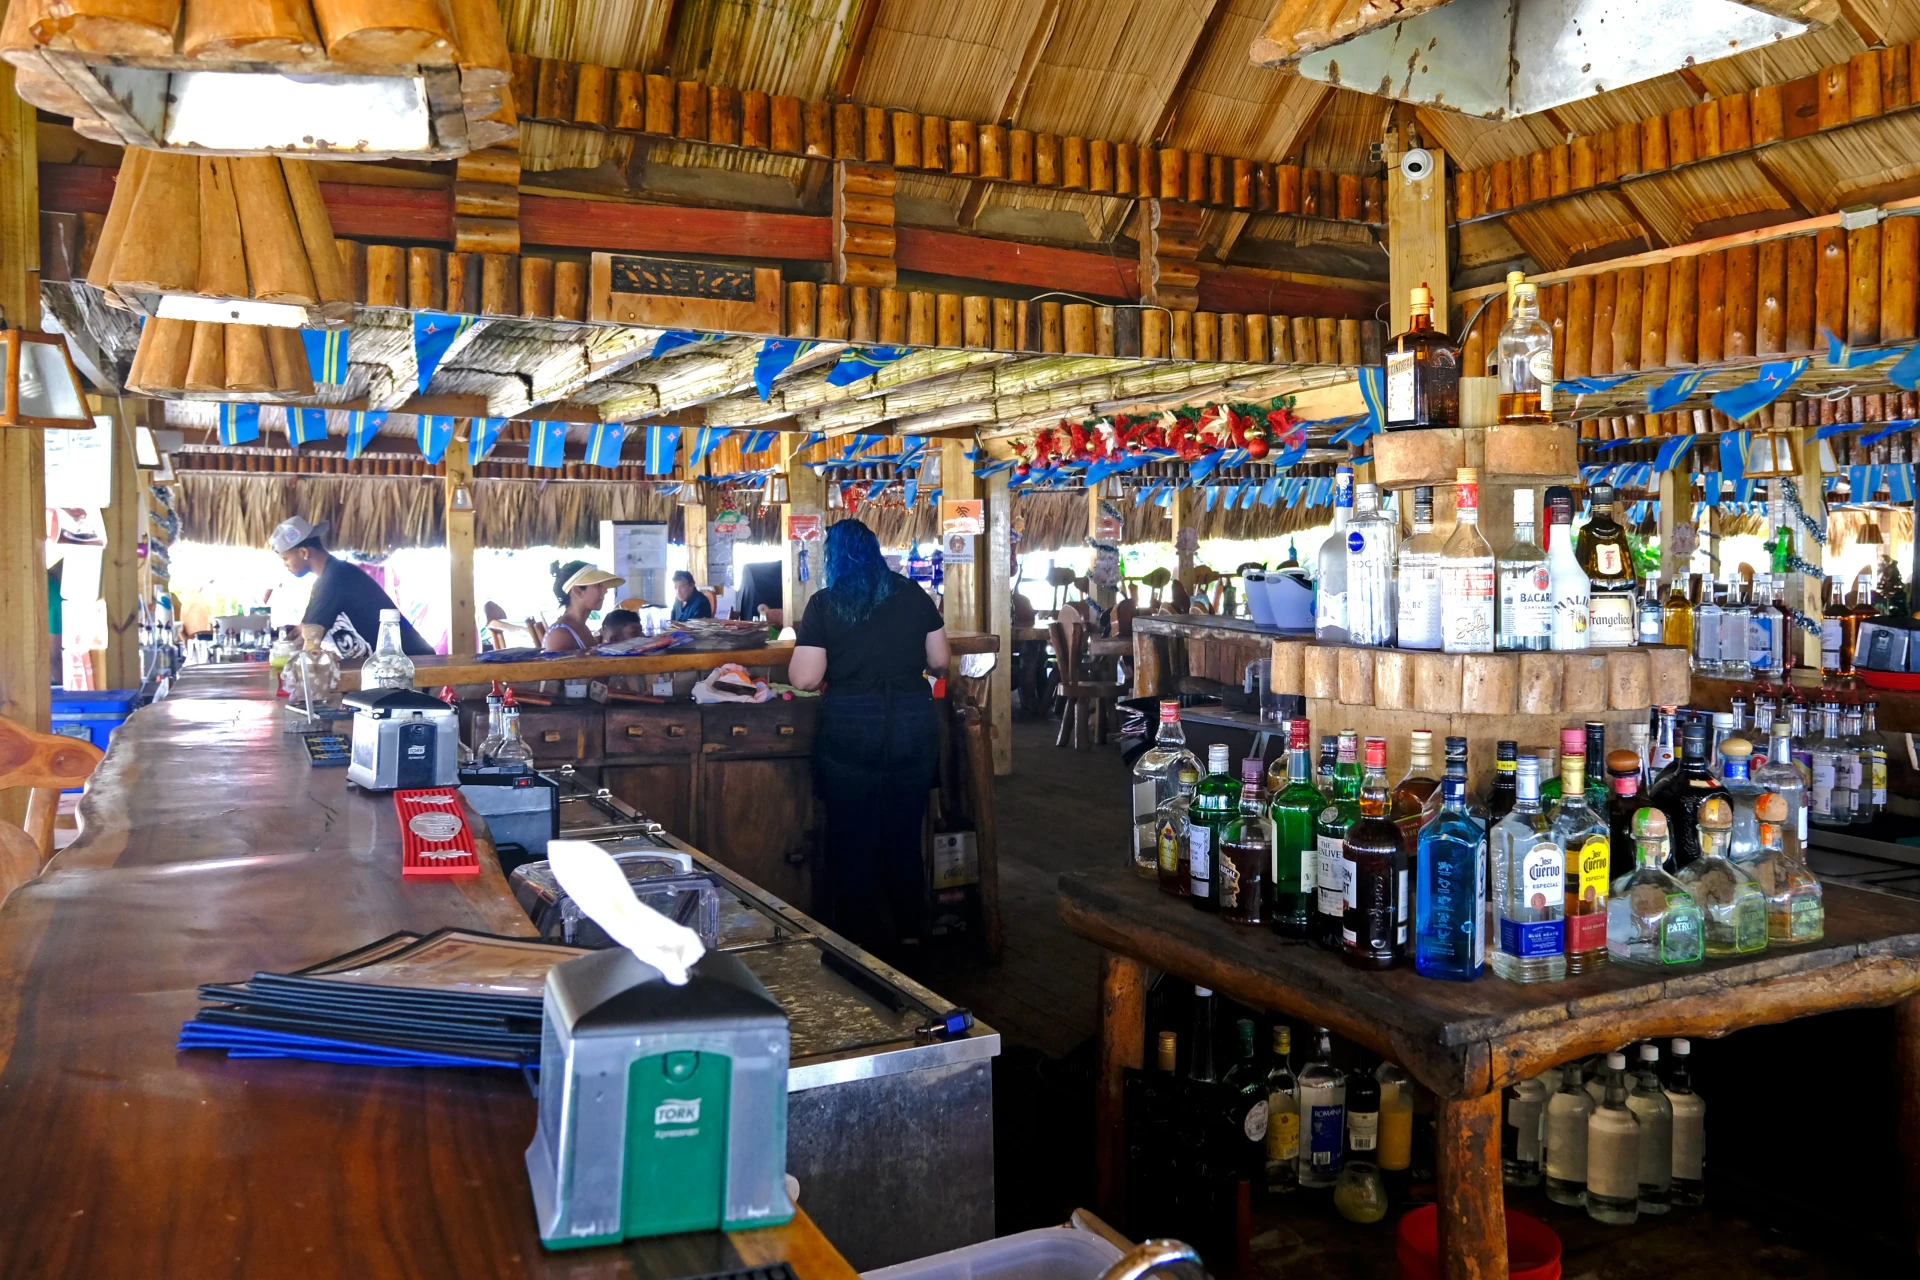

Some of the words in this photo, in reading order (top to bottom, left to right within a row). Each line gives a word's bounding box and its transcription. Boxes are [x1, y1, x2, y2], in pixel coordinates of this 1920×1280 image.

[1318, 848, 1342, 859] ENLIVE
[1322, 863, 1329, 872] 12
[1584, 857, 1607, 873] Cuervo
[1529, 863, 1560, 881] Cuervo
[659, 1108, 696, 1120] TORK
[1314, 1108, 1342, 1118] ROMANA
